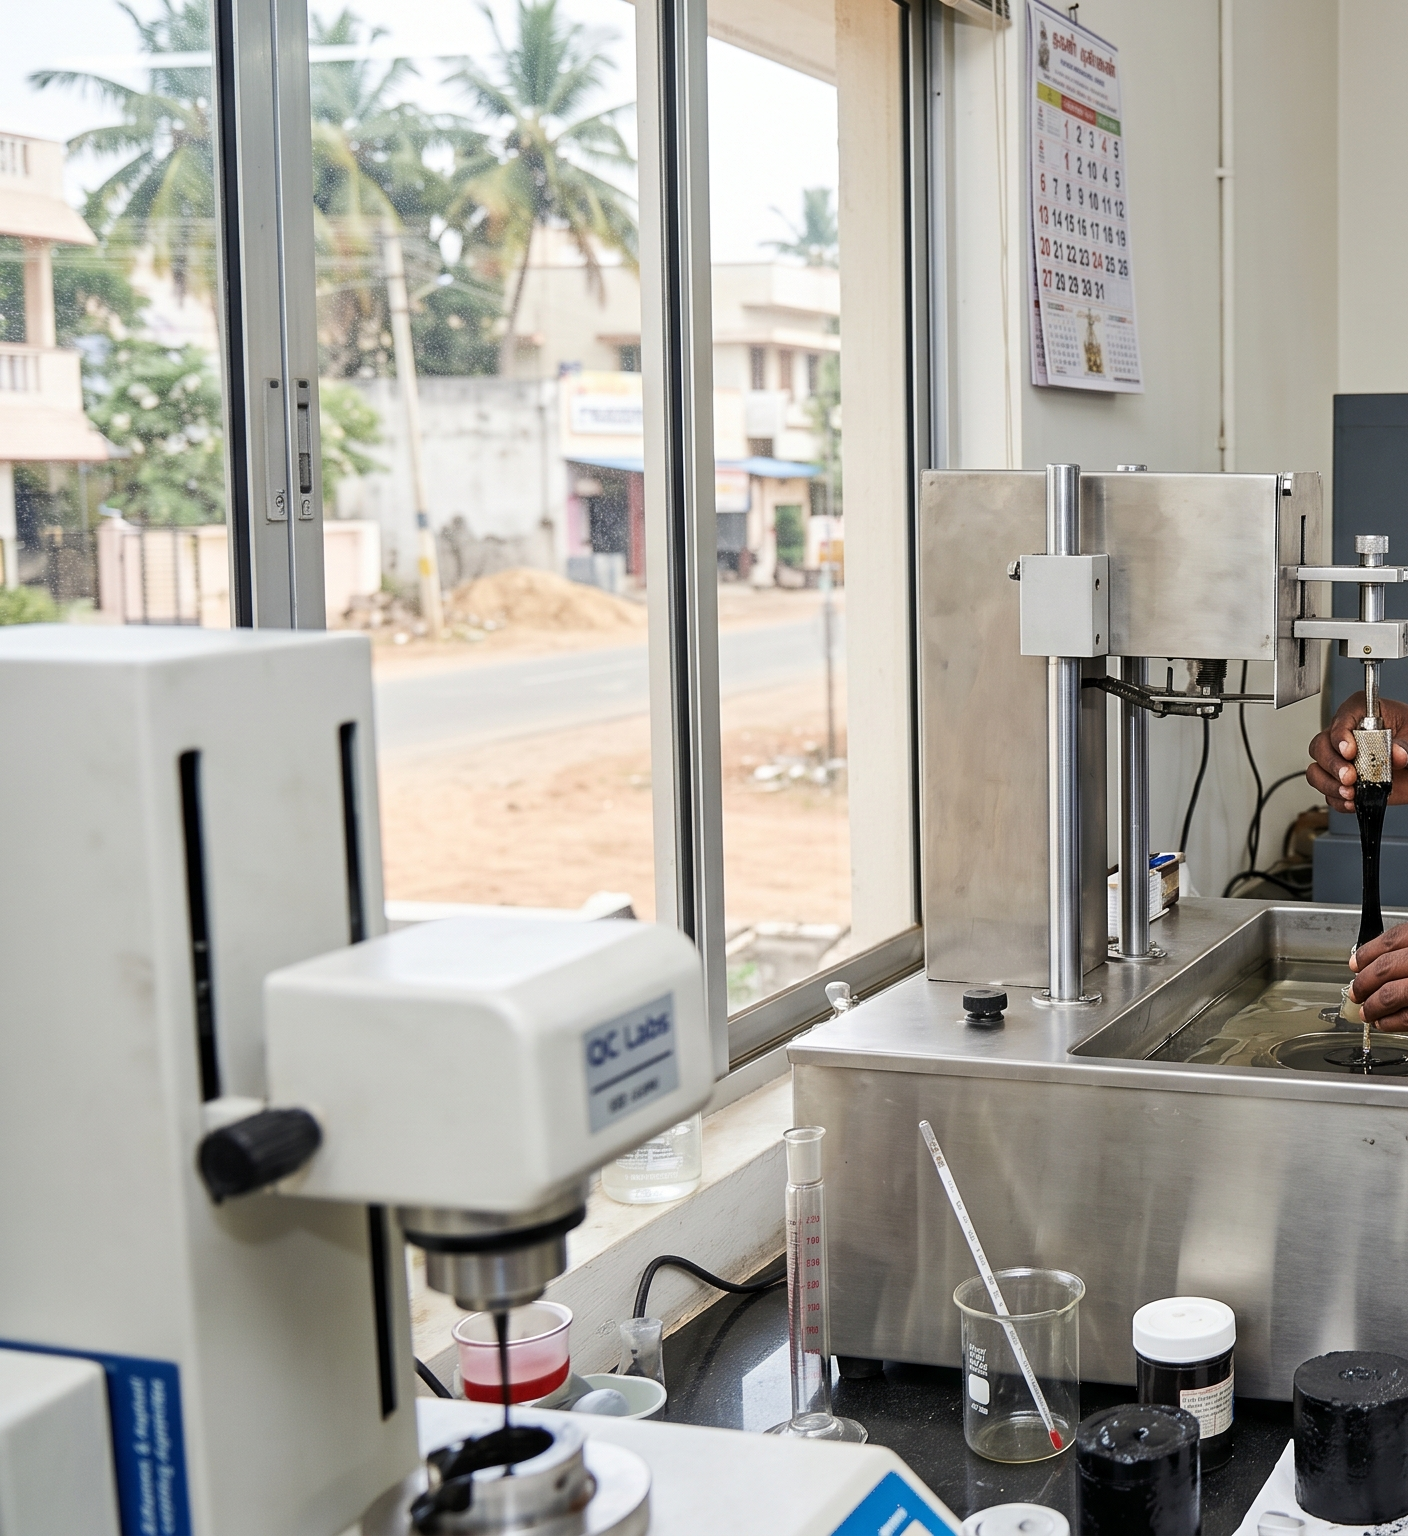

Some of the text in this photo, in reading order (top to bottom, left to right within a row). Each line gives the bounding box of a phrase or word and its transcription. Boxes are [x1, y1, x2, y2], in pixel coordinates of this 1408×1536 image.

[1077, 125, 1082, 144] 2
[1089, 131, 1094, 149] 3
[1102, 137, 1107, 153] 4
[1064, 152, 1069, 171] 1
[1077, 157, 1082, 175] 2
[1102, 167, 1108, 182] 4
[1040, 173, 1046, 192] 6
[1053, 178, 1058, 195] 7
[1089, 191, 1098, 210] 10
[1102, 196, 1112, 214] 11
[1115, 200, 1124, 218] 12
[1039, 205, 1048, 225] 13
[1052, 209, 1062, 228] 14
[1090, 221, 1099, 240] 17
[1040, 237, 1050, 257] 20
[1053, 240, 1063, 260] 21
[1067, 244, 1077, 264] 22
[1079, 248, 1089, 267] 23
[1092, 251, 1103, 270] 24
[1043, 268, 1052, 288] 27
